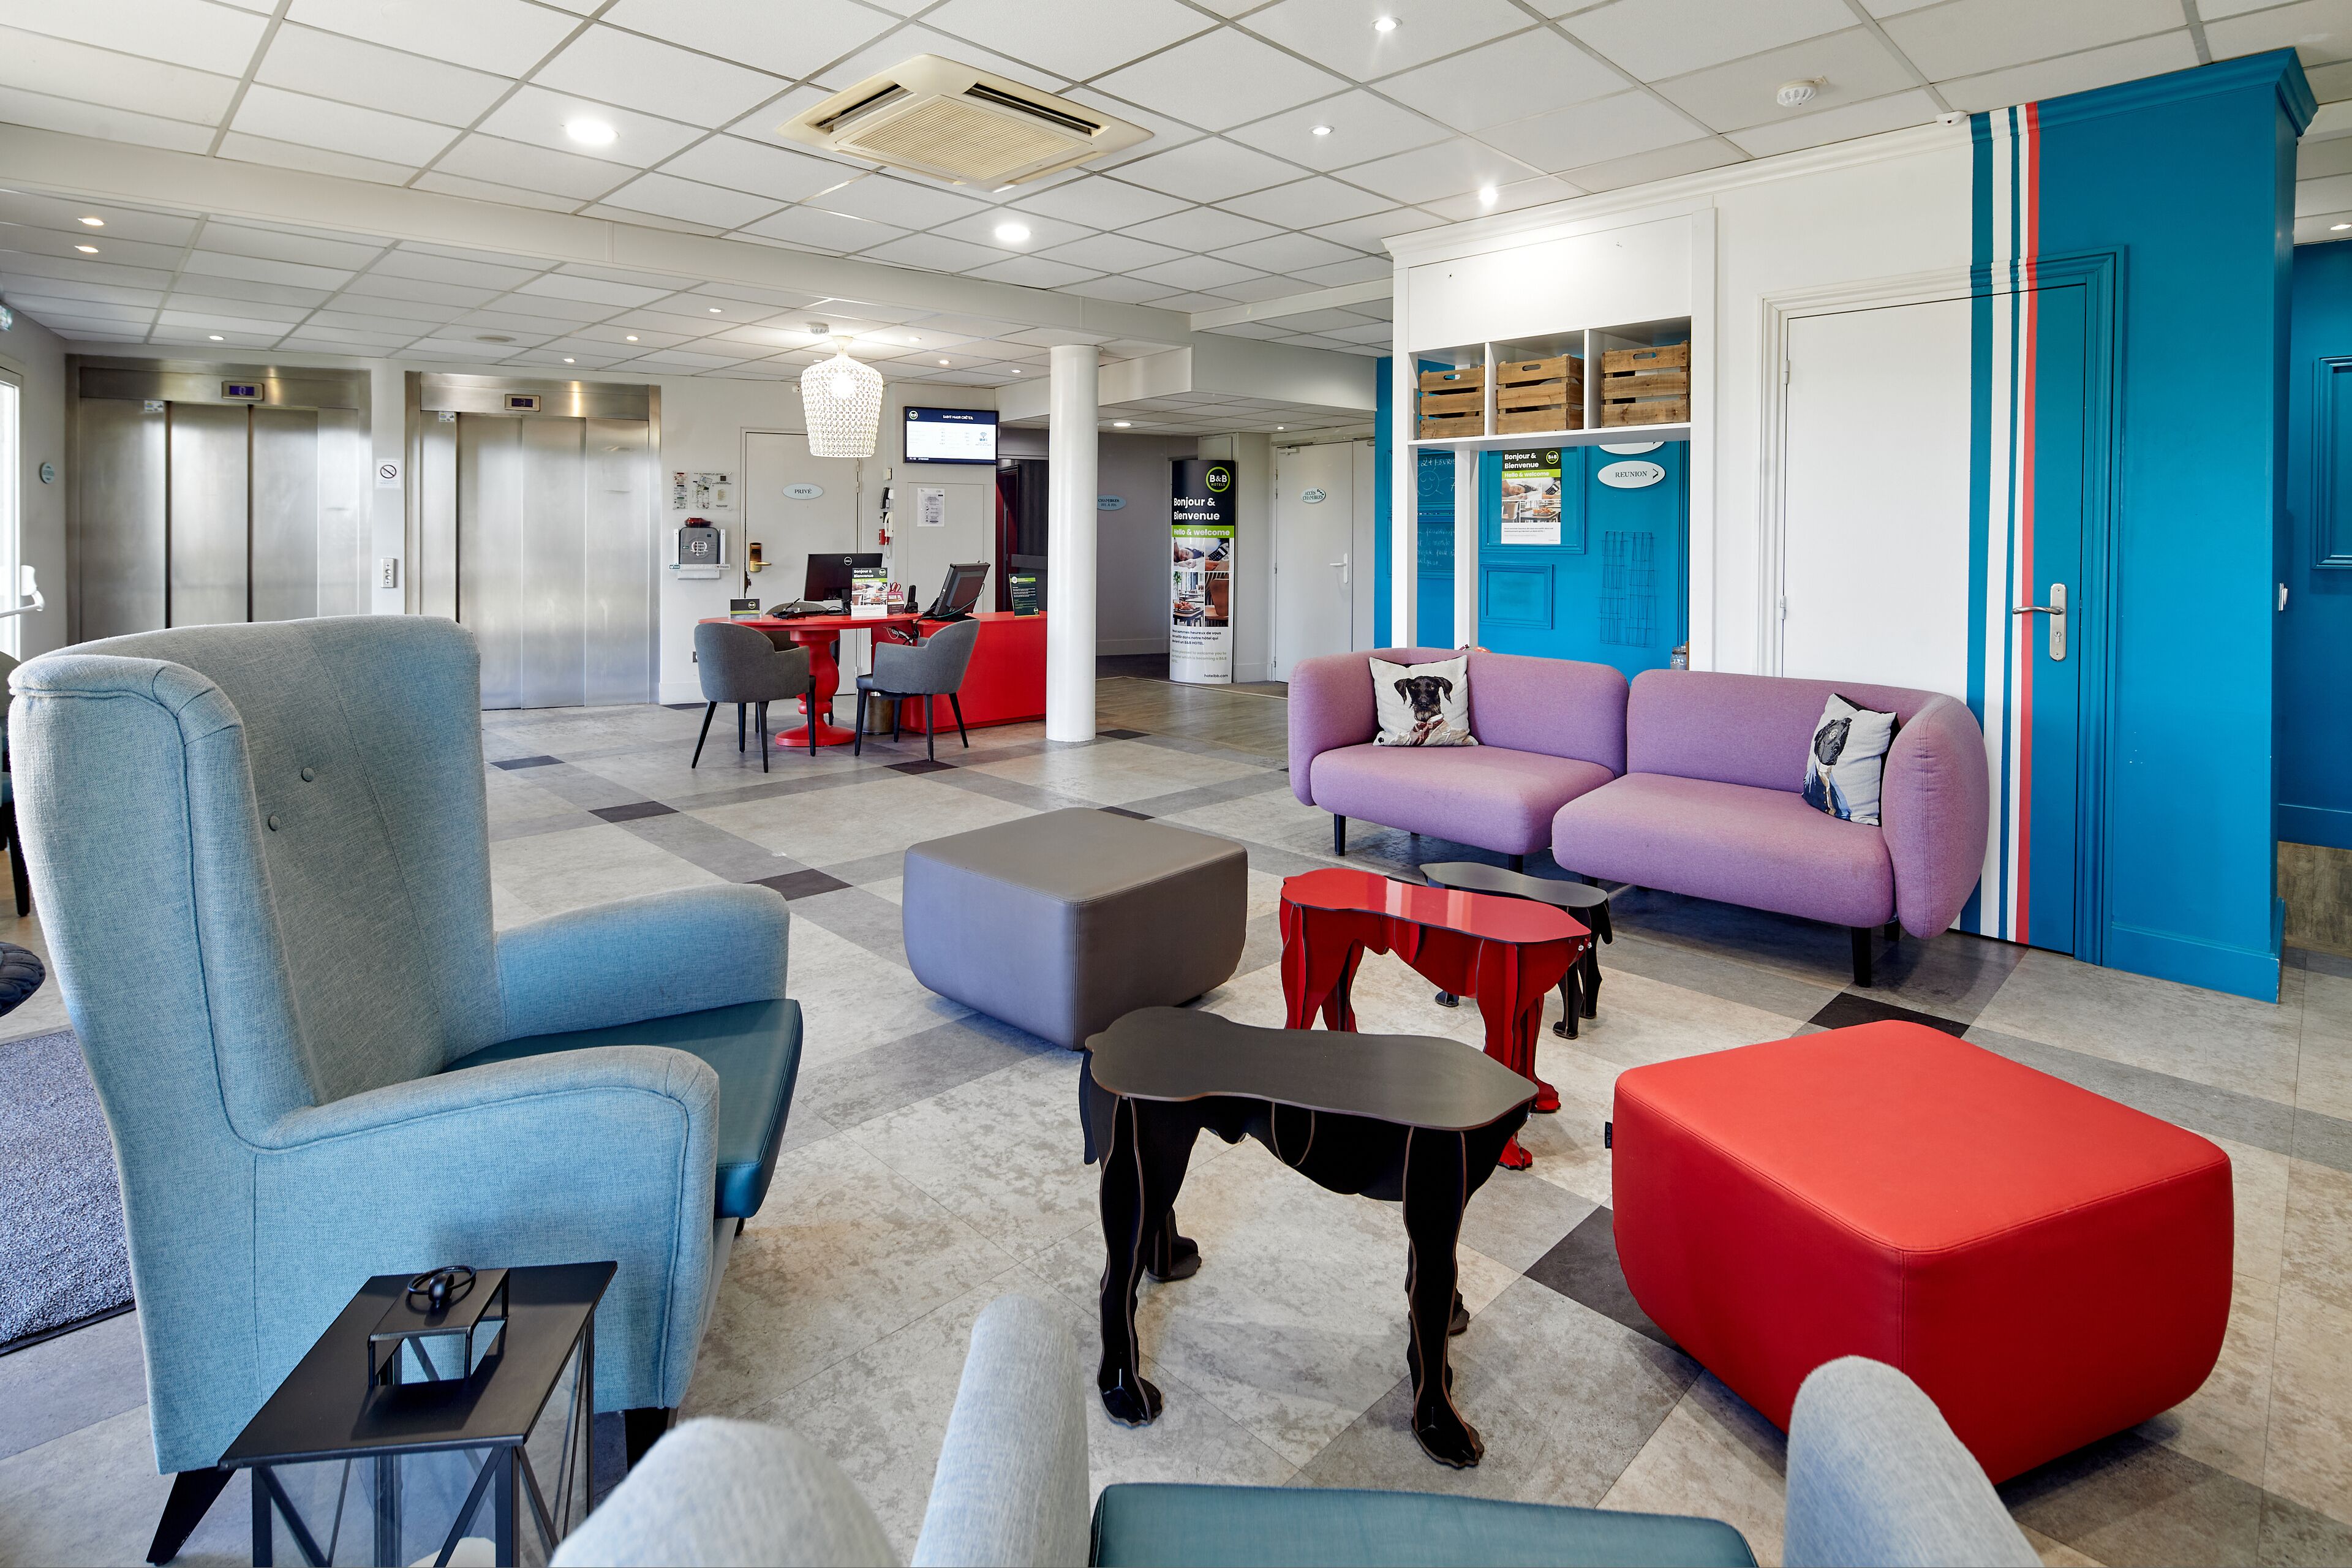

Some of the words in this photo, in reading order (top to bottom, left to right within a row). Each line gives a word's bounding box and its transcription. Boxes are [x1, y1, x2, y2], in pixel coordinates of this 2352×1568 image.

[1209, 474, 1227, 483] B&B
[1174, 497, 1205, 508] Bonjour
[1207, 497, 1216, 507] &
[1174, 511, 1220, 520] Bienvenue
